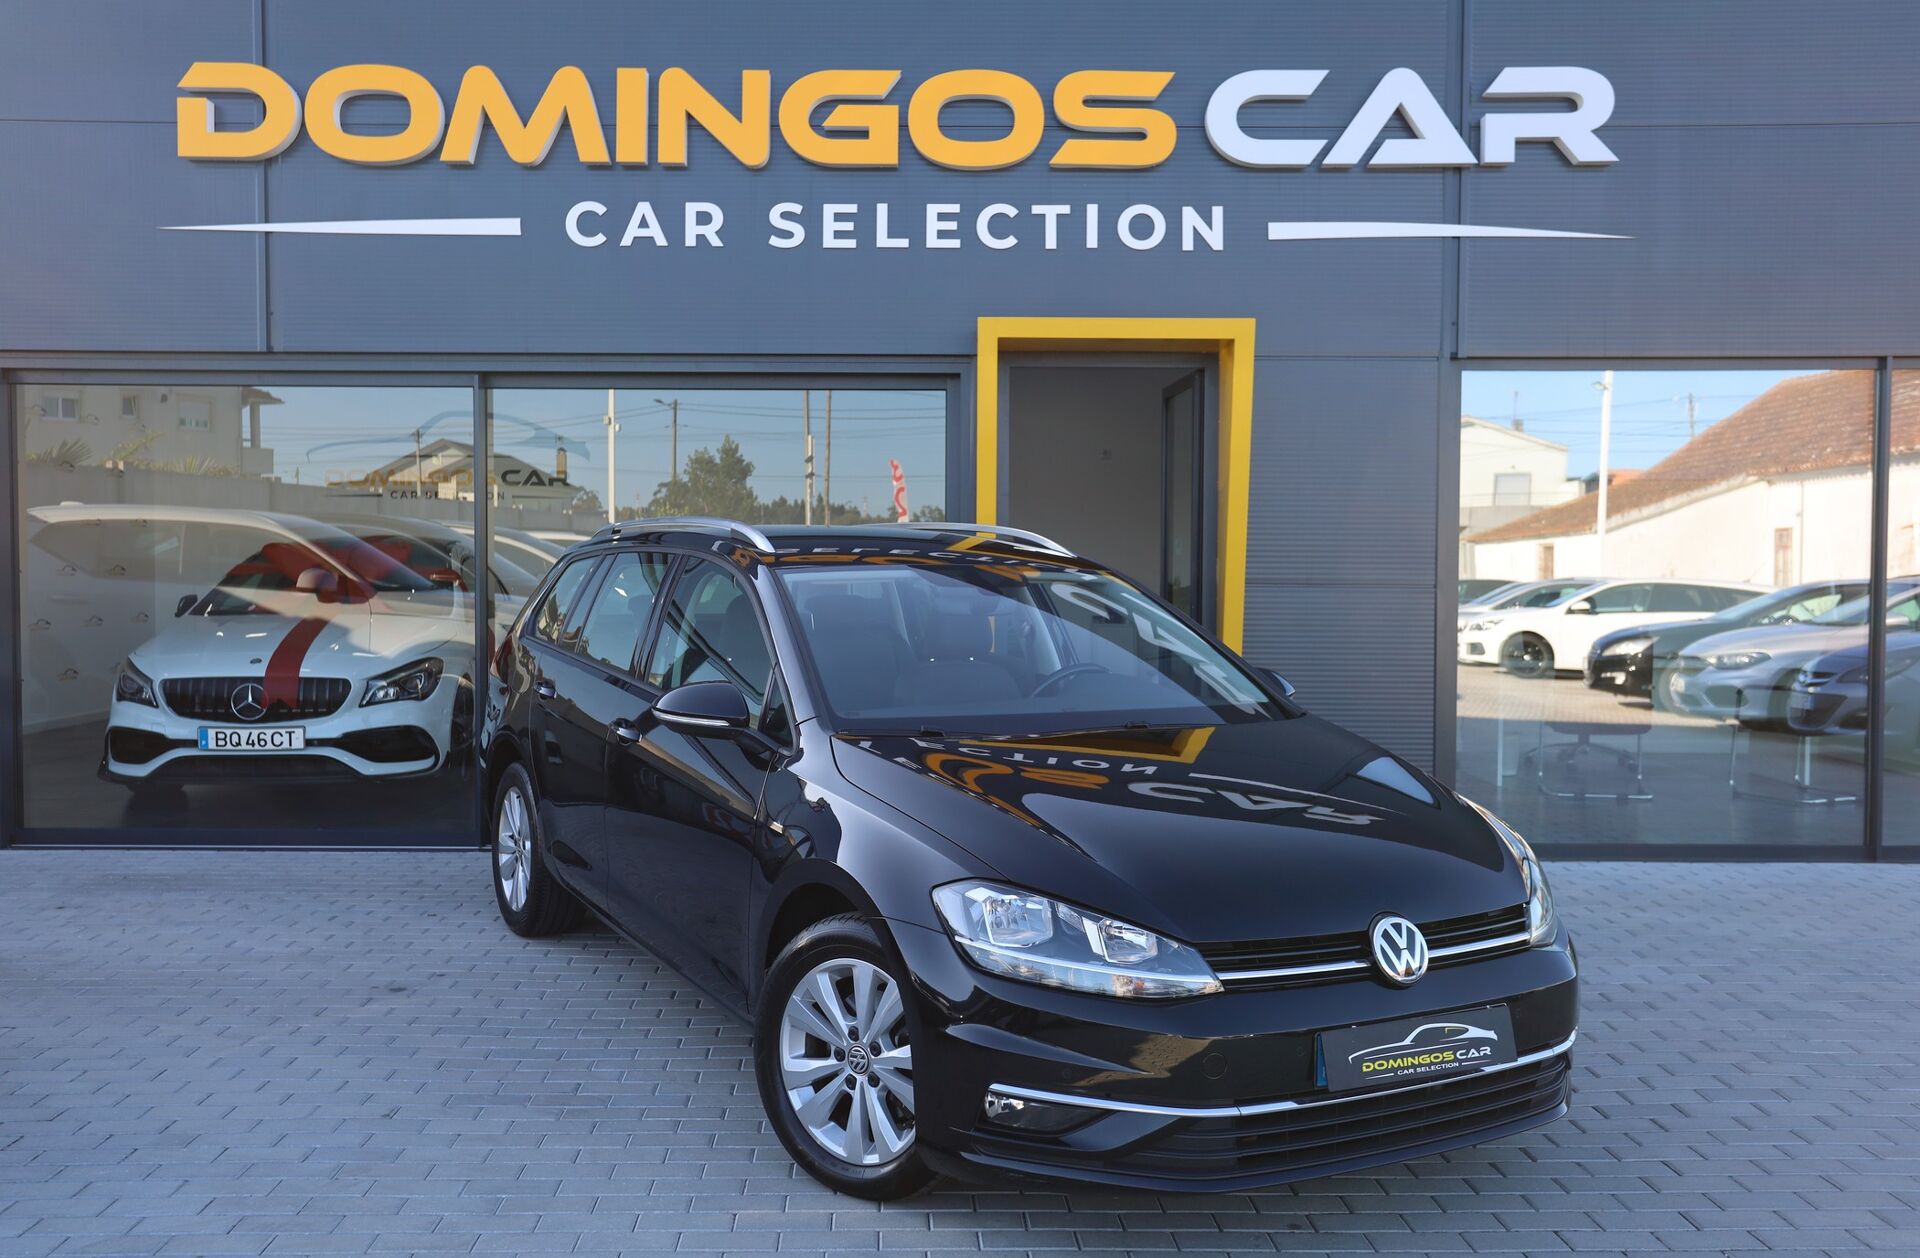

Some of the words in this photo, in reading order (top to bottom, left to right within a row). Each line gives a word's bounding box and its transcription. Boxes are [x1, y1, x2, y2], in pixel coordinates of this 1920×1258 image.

[176, 62, 1177, 168] DOMINGOS
[1204, 65, 1620, 167] CAR
[565, 200, 724, 248] CAR
[768, 202, 1225, 252] SELECTION
[501, 468, 569, 487] CAR
[1362, 1050, 1455, 1073] DOMINGOS
[1455, 1046, 1492, 1060] CAR
[1397, 1068, 1415, 1076] CAR
[1416, 1061, 1460, 1073] SELECTION
